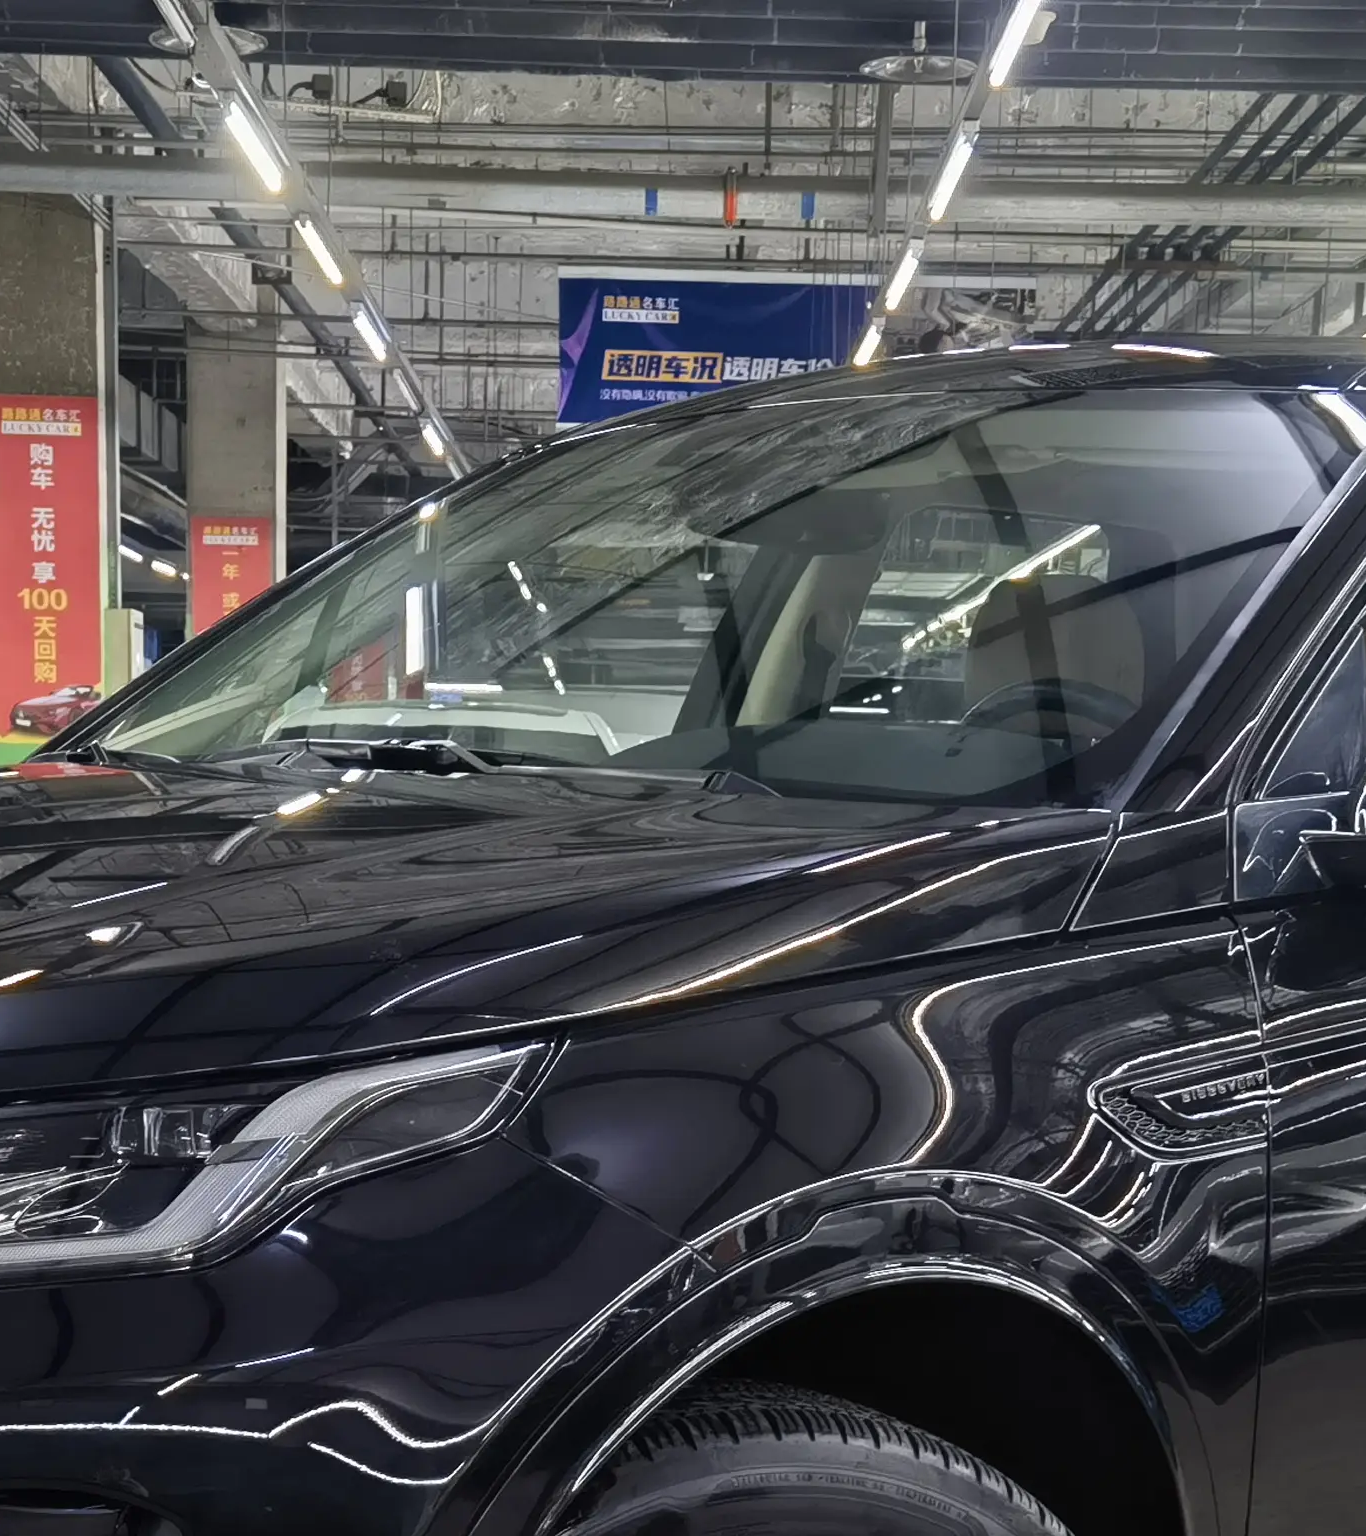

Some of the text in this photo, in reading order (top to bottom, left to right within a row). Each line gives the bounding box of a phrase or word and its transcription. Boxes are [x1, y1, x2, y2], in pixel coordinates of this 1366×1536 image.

[608, 353, 717, 380] 透明车况
[3, 422, 71, 434] LUCKY CAR
